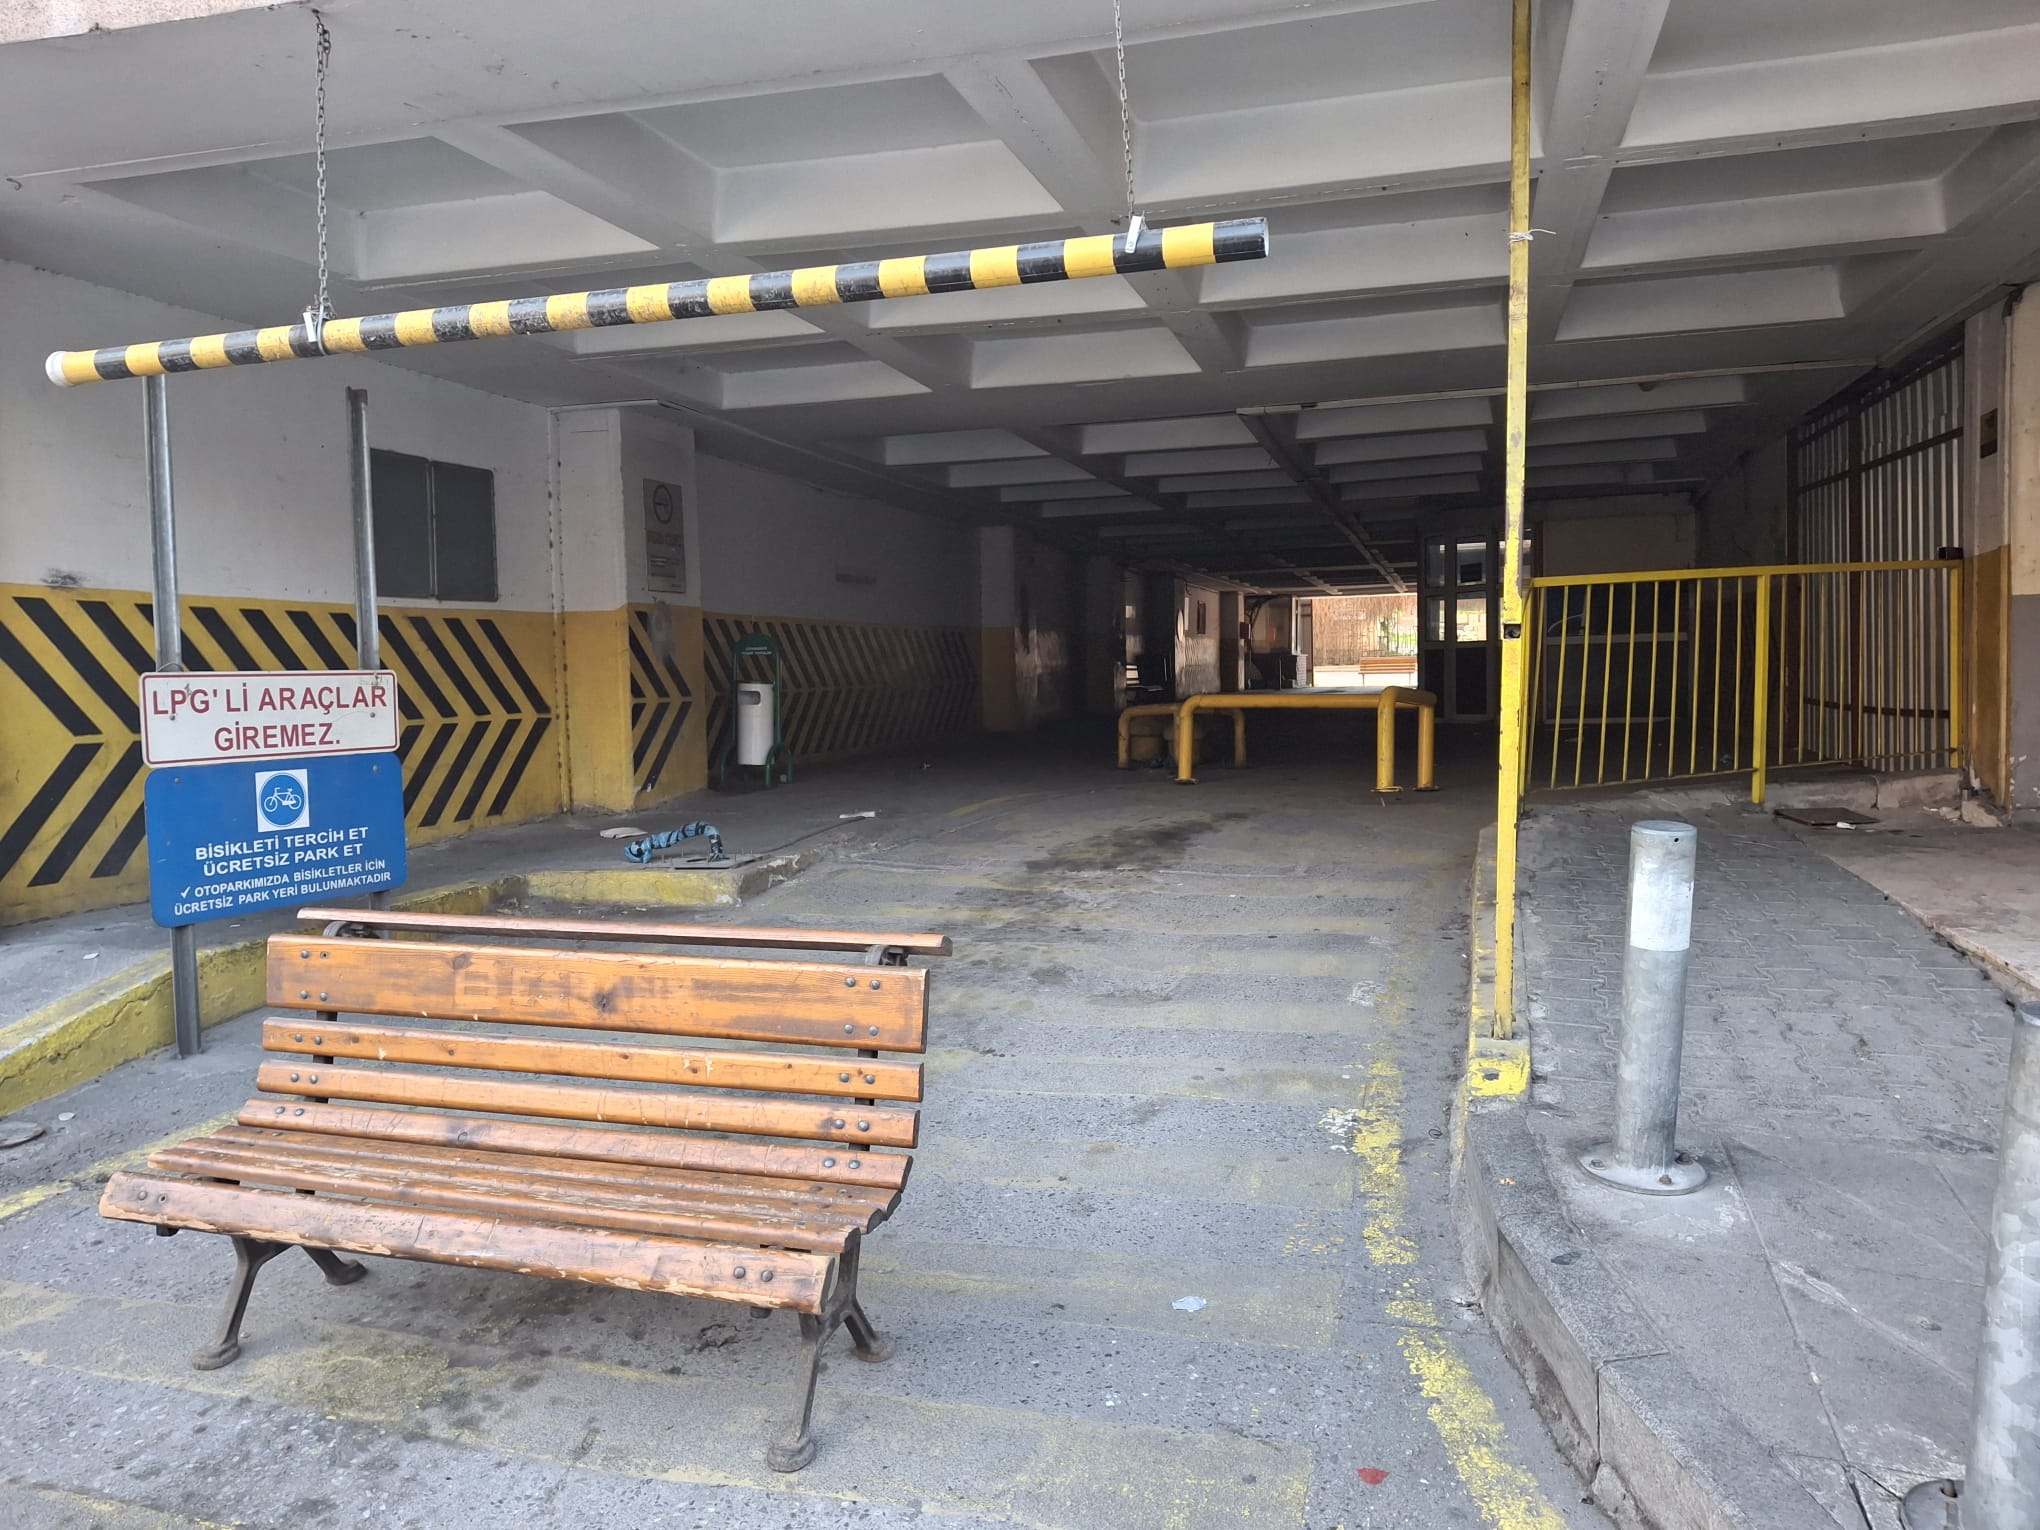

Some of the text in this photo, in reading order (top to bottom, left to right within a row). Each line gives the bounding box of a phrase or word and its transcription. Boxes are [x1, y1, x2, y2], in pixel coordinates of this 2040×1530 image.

[153, 682, 388, 715] LPG'Lİ ARAÇLAR
[214, 721, 341, 752] GİREMEZ.
[195, 826, 369, 860] BİSİKLETİ TERCİH ET
[203, 843, 364, 877] ÜCRETSİZ PARK ET
[174, 871, 392, 915] ÜCRETSİZ PARK YERİ BULUNMAKTADIR
[194, 875, 290, 898] OTOPARKIMIZDA
[293, 864, 363, 882] BİSİKLETLER
